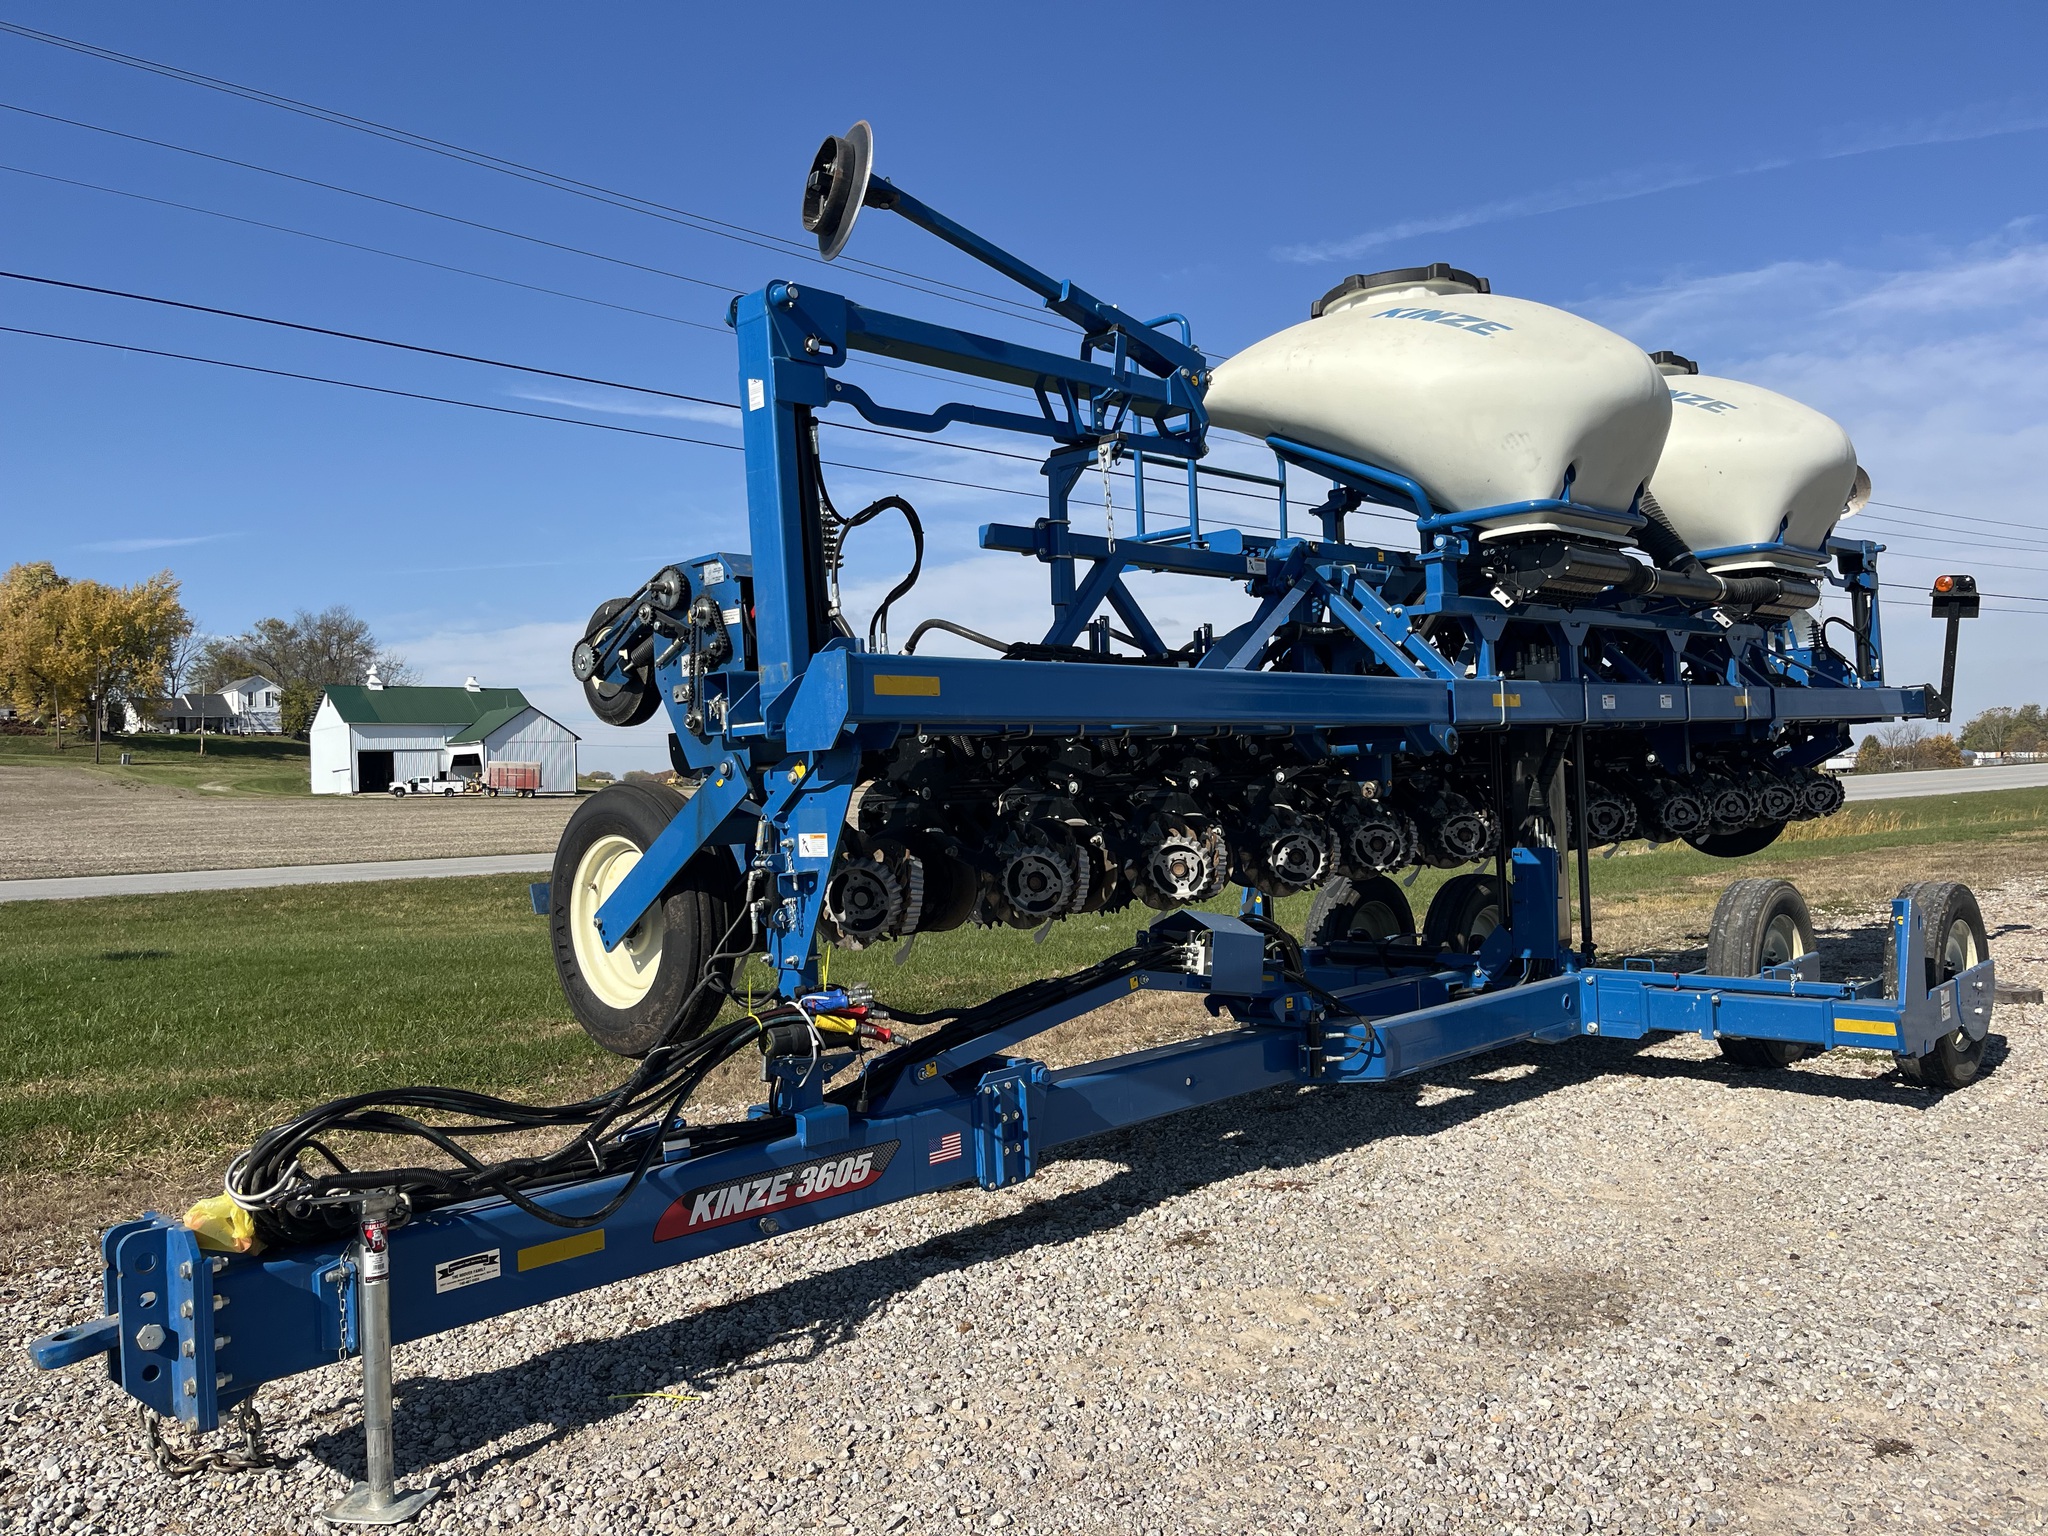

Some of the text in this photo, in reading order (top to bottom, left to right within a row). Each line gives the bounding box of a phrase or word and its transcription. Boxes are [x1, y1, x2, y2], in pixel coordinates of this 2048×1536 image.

[1369, 307, 1514, 337] KINZE
[1669, 389, 1739, 414] NZE
[555, 901, 577, 981] TITAN
[688, 1152, 874, 1226] KINZE 3605
